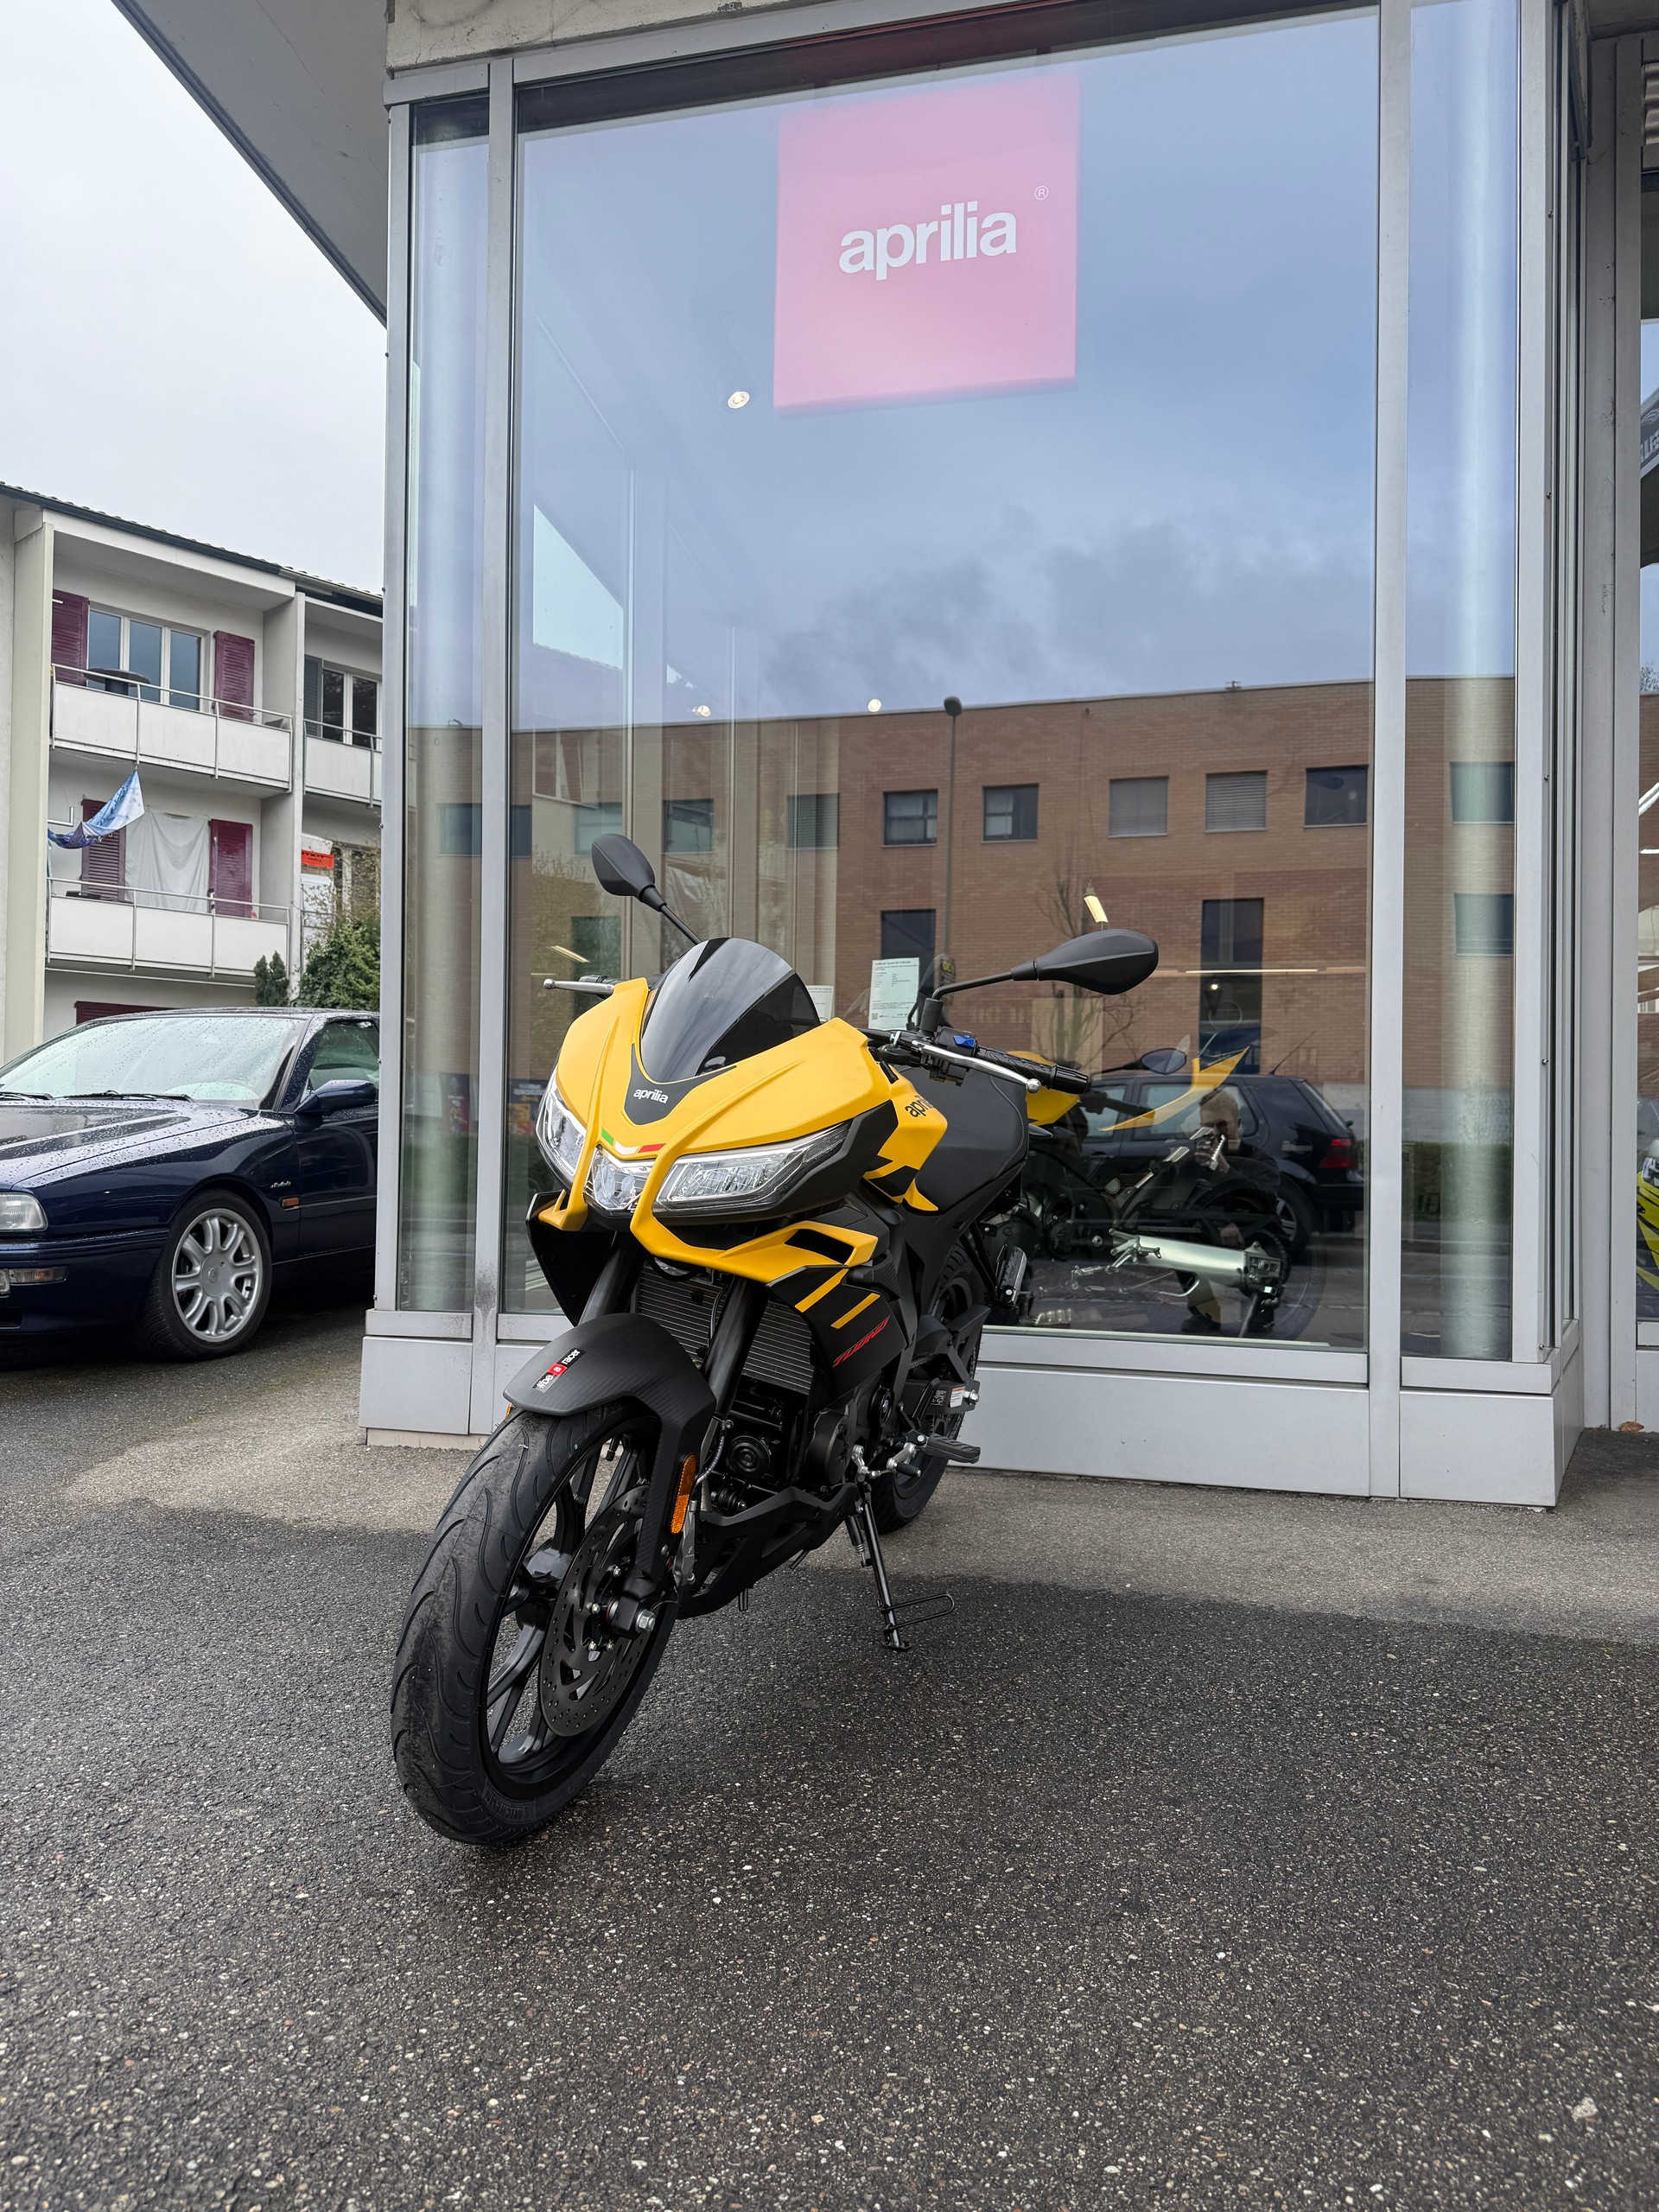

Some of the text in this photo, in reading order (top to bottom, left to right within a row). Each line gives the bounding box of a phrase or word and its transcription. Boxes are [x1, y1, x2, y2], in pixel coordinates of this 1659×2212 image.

[839, 200, 1017, 281] aprilia
[633, 1089, 669, 1104] aprilia
[561, 1349, 581, 1365] racer
